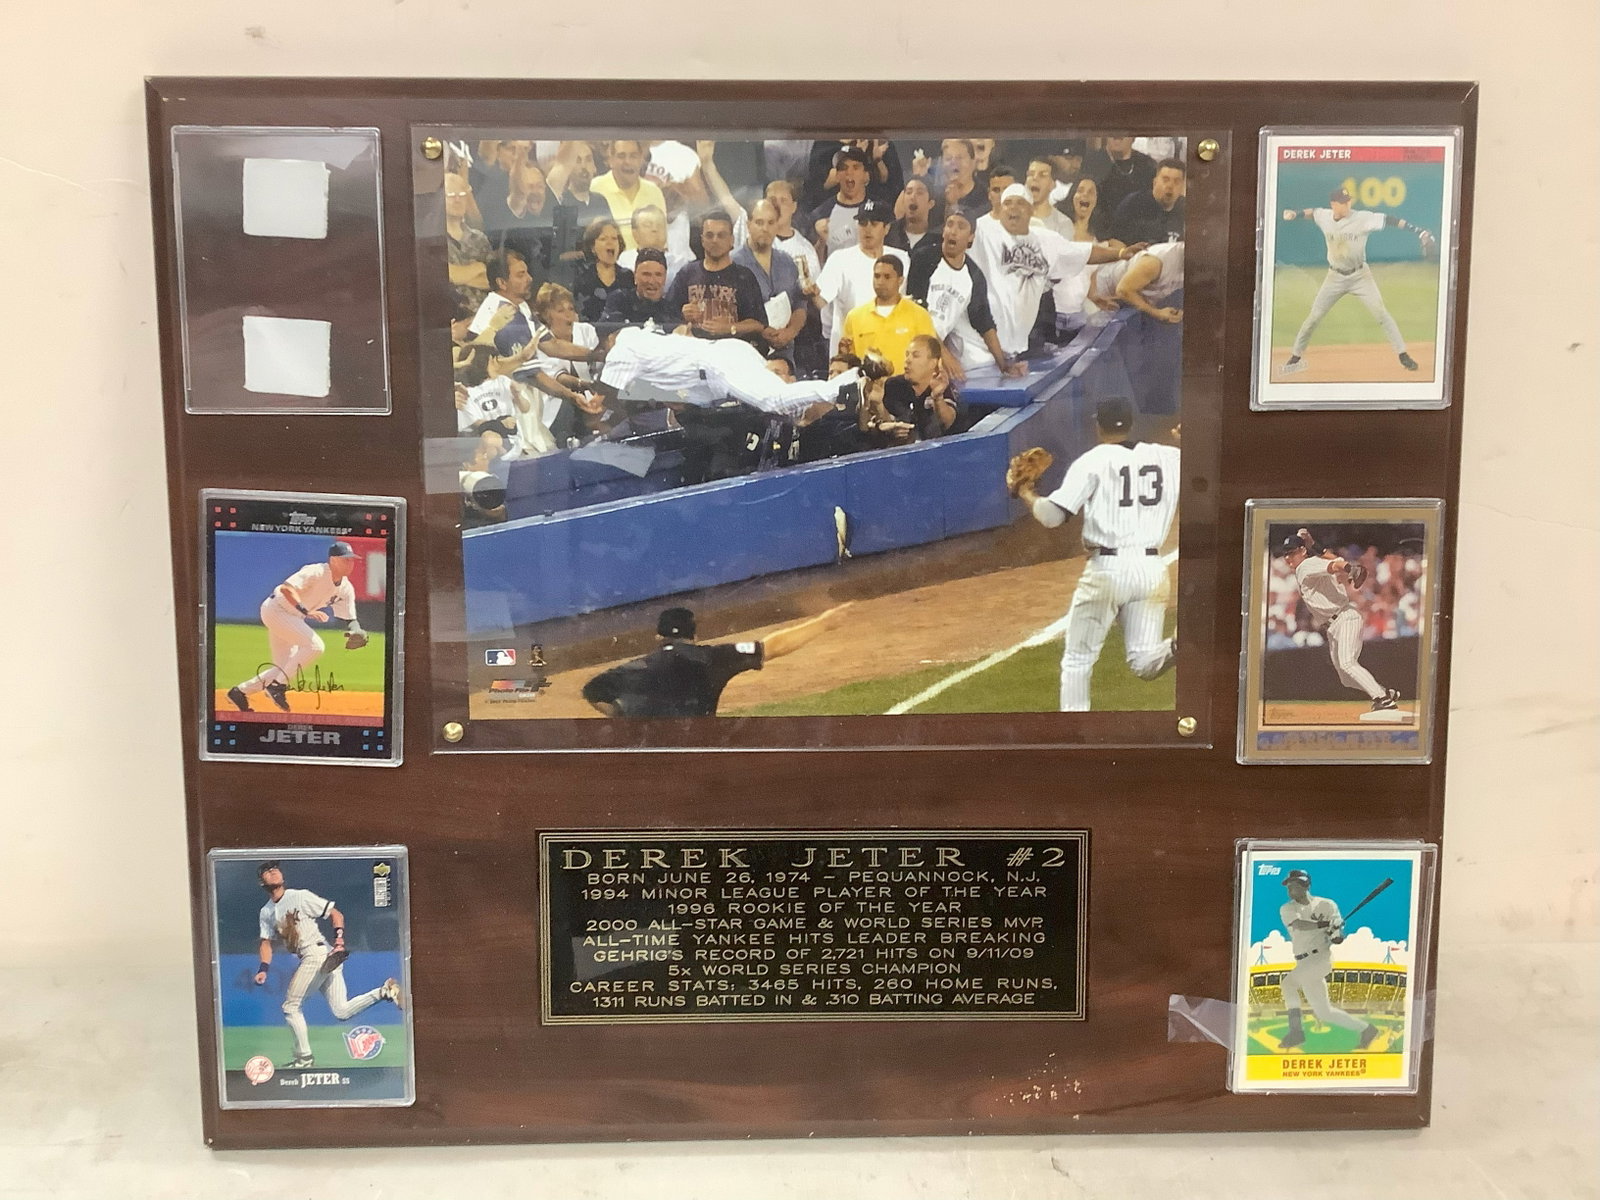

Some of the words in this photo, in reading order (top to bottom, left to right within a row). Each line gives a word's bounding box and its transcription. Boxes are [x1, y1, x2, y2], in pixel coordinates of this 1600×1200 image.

[1283, 149, 1316, 159] DEREK
[1319, 149, 1351, 159] JETER
[1119, 465, 1163, 506] 13
[251, 523, 273, 532] NEW
[275, 525, 302, 533] YORK
[259, 729, 341, 745] JETER
[562, 849, 750, 869] DEREK
[791, 848, 965, 869] JETER
[1006, 847, 1066, 868] #2
[588, 873, 645, 884] BORN
[657, 873, 712, 883] JUNE
[725, 872, 755, 884] 26,
[766, 872, 811, 883] 1974
[849, 872, 995, 883] PEQUANNOCK,
[1007, 872, 1040, 883] N.J.
[581, 889, 629, 900] 1994
[641, 888, 707, 899] MINOR
[721, 888, 800, 899] LEAGUE
[813, 887, 892, 898] PLAYER
[904, 887, 931, 897] OF
[942, 887, 981, 897] THE
[994, 887, 1047, 897] YEAR
[667, 903, 715, 915] 1996
[728, 903, 806, 914] ROOKIE
[819, 902, 845, 913] OF
[857, 902, 896, 913] THE
[909, 902, 961, 913] YEAR
[586, 920, 637, 931] 2000
[648, 919, 742, 930] ALL-STAR
[753, 918, 806, 929] GAME
[817, 918, 833, 929] &
[844, 917, 910, 928] WORLD
[921, 917, 992, 928] SERIES
[583, 935, 680, 946] ALL-TIME
[693, 934, 775, 945] YANKEE
[789, 933, 834, 944] HITS
[847, 933, 927, 944] LEADER
[940, 933, 1046, 943] BREAKING
[593, 950, 684, 962] GEHRIG'S
[695, 949, 776, 960] RECORD
[786, 949, 811, 960] OF
[876, 948, 918, 959] HITS
[929, 948, 955, 959] ON
[966, 948, 1034, 959] 9/11/09
[668, 965, 691, 976] 5x
[703, 964, 769, 975] WORLD
[780, 964, 851, 975] SERIES
[862, 963, 961, 974] CHAMPION
[569, 981, 655, 993] CAREER
[668, 980, 735, 991] STATS:
[748, 979, 800, 990] 3465
[873, 979, 913, 989] 260
[925, 978, 984, 989] HOME
[592, 997, 624, 1008] 1311
[635, 996, 686, 1007] RUNS
[696, 995, 766, 1006] BATTED
[776, 995, 792, 1006] IN
[801, 995, 817, 1005] &
[825, 994, 859, 1005] .310
[869, 994, 943, 1004] BATTING
[952, 993, 1035, 1004] AVERAGE
[1282, 1060, 1322, 1069] DEREK
[1329, 1059, 1367, 1068] JETER
[301, 1073, 340, 1088] JETER
